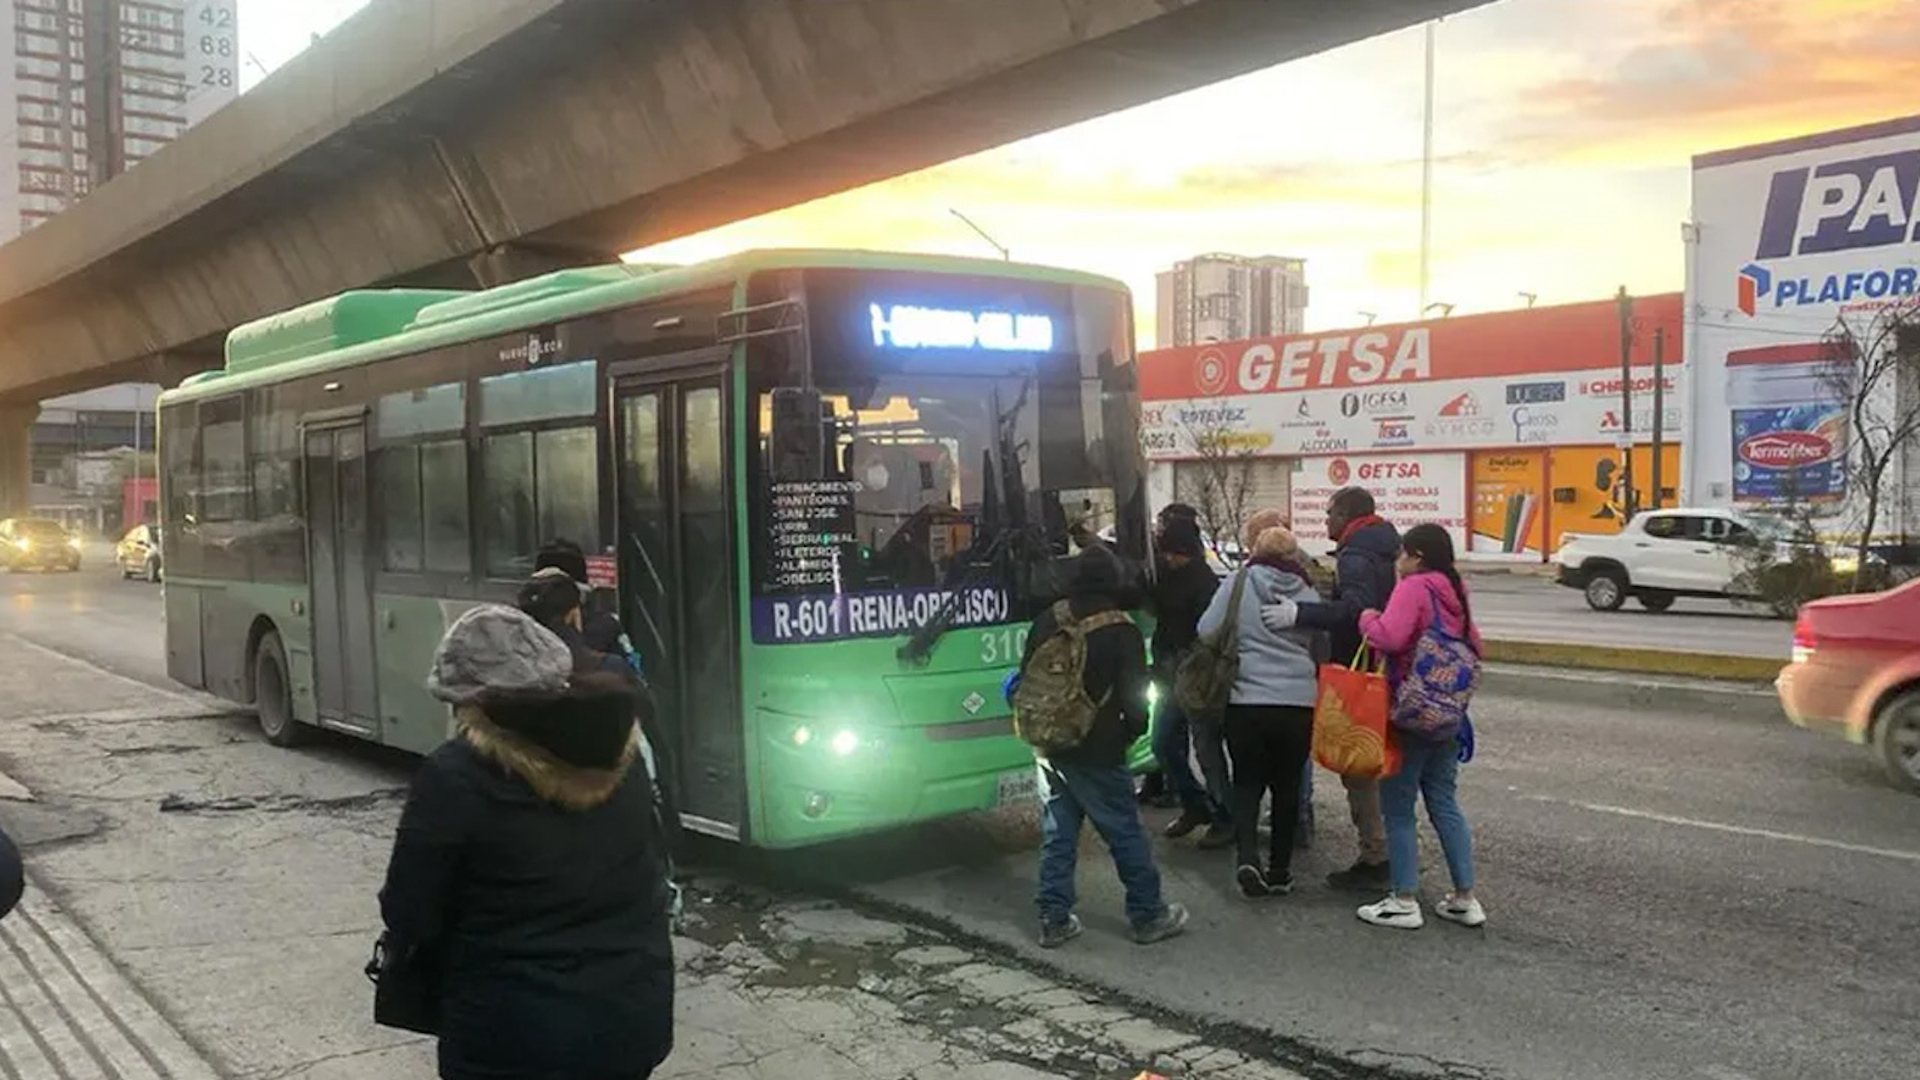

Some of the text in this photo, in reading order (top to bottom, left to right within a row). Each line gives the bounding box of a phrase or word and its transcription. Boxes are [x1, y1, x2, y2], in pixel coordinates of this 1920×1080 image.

[199, 5, 231, 28] 42
[200, 35, 231, 58] 68
[200, 64, 232, 88] 28
[1775, 266, 1920, 308] PLAFOR
[1237, 327, 1431, 392] GETSA
[1357, 462, 1421, 480] GETSA
[1828, 462, 1845, 486] 5
[780, 559, 840, 572] ALAMED
[780, 571, 841, 586] OBELISC
[773, 598, 841, 639] R-601
